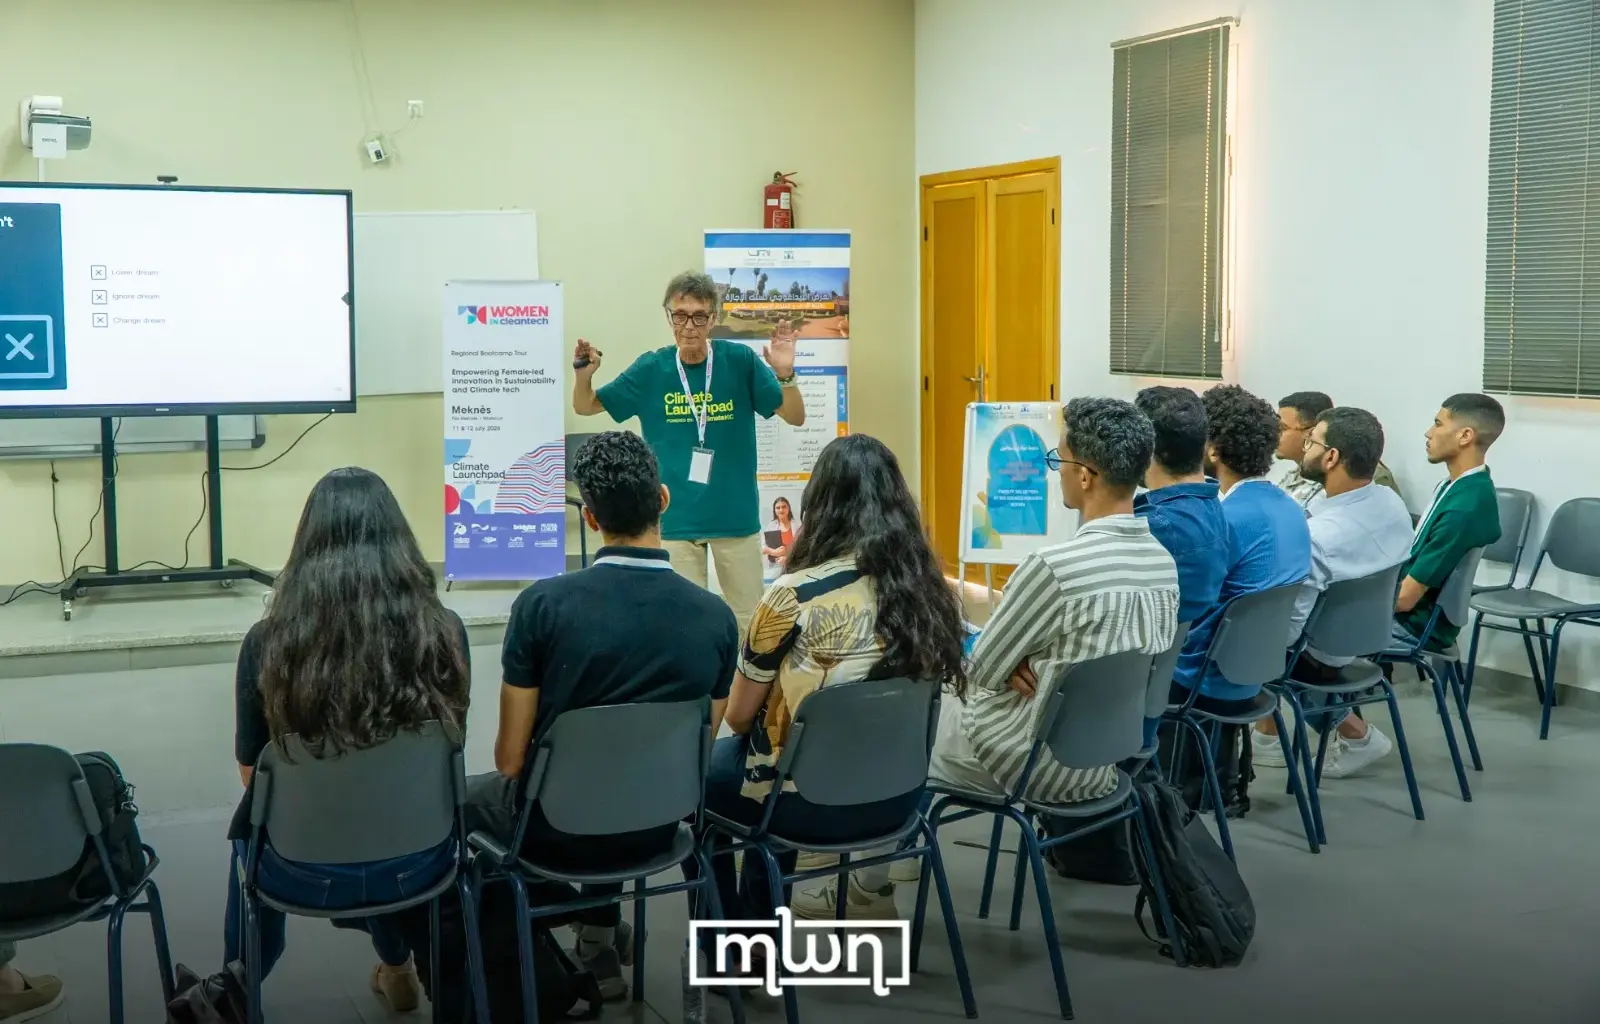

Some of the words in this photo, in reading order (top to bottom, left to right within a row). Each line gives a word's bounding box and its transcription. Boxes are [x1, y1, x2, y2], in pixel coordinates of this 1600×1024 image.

[490, 305, 549, 317] WOMEN
[499, 317, 549, 325] cleantech
[451, 368, 500, 376] Empowering
[501, 368, 545, 376] Female-led
[504, 377, 556, 385] Sustainability
[469, 386, 501, 394] Climate
[502, 386, 520, 394] tech
[452, 405, 491, 414] Meknès
[452, 462, 490, 471] Climate
[453, 470, 505, 479] Launchpad
